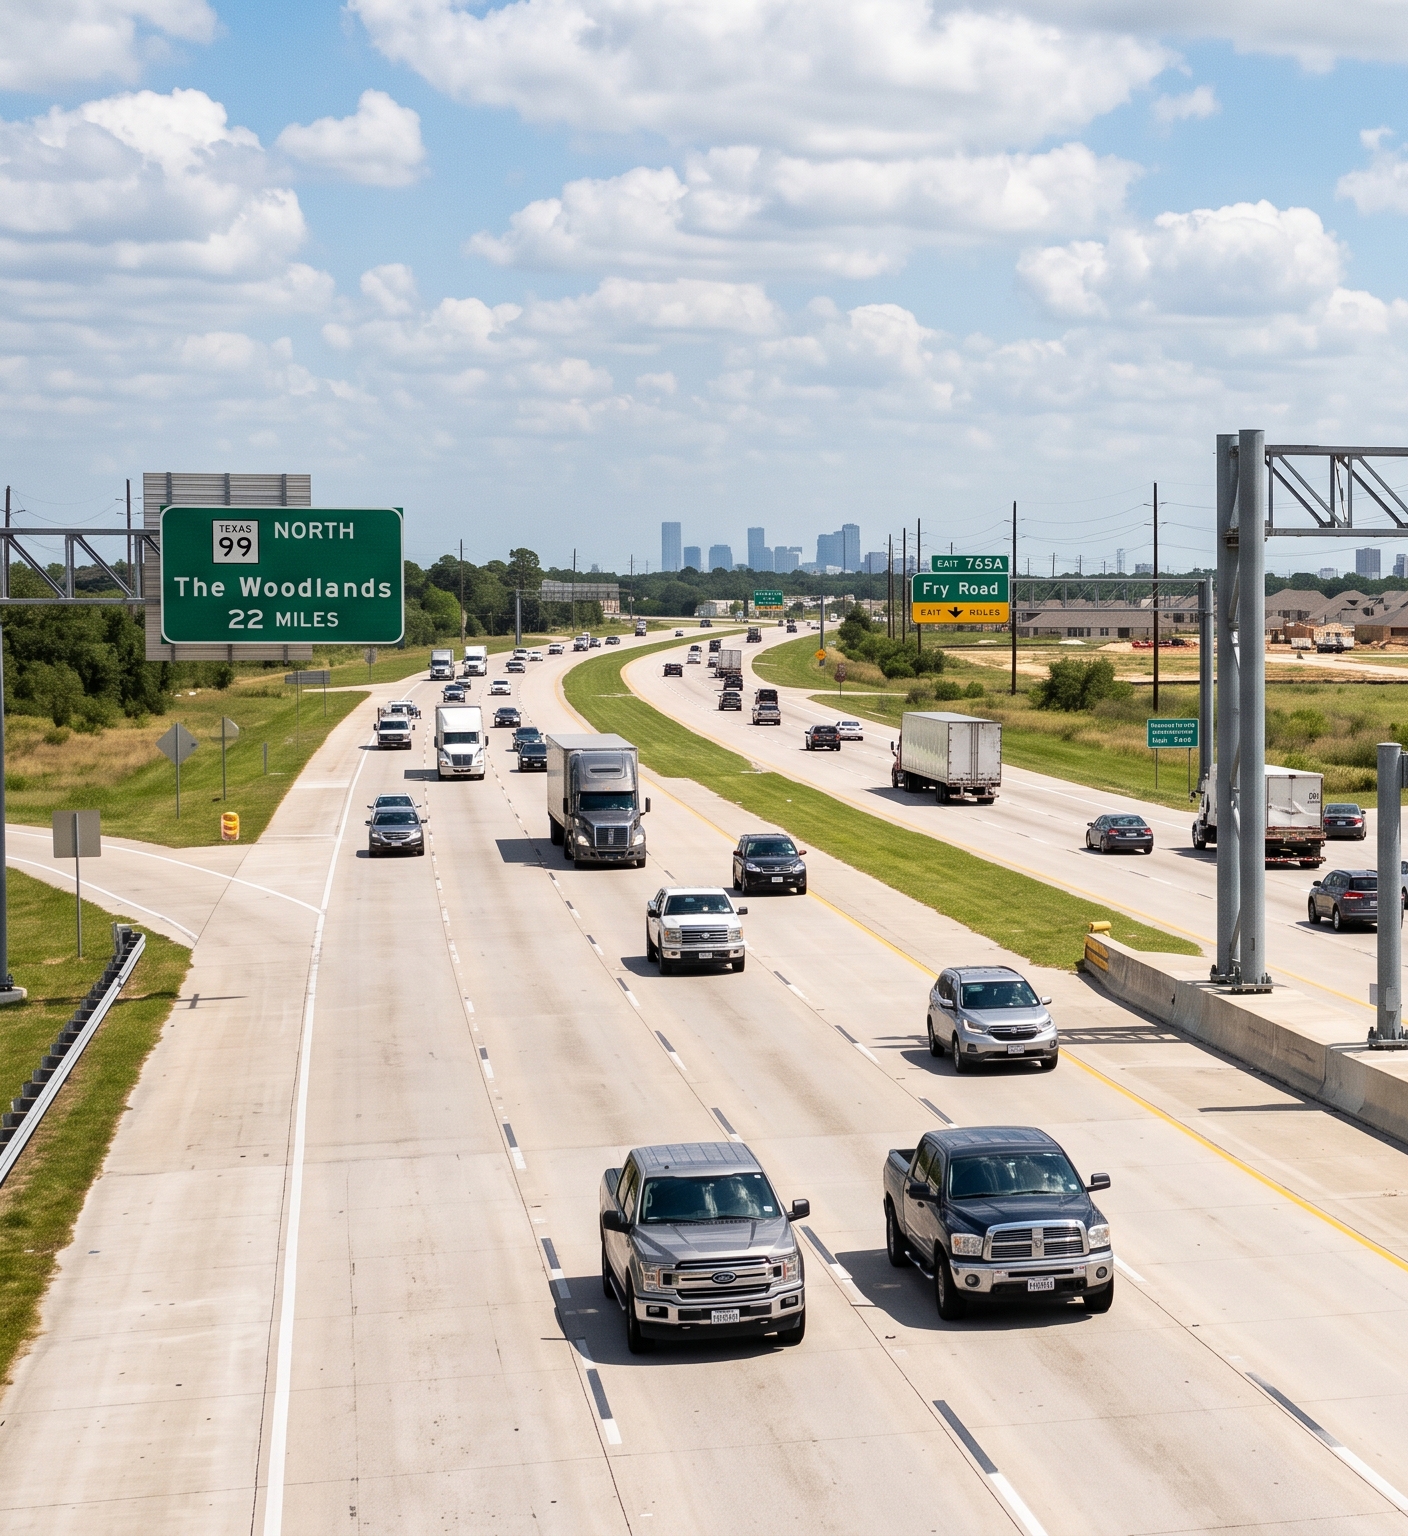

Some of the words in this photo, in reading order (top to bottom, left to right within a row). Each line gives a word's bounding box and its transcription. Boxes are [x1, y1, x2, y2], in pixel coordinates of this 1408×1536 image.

[218, 524, 252, 534] TEXAS
[274, 521, 354, 540] NORTH
[218, 536, 252, 558] 99
[965, 557, 1003, 570] 765A
[173, 576, 226, 598] The
[239, 576, 392, 598] Woodlands
[923, 582, 950, 598] Fry
[958, 581, 999, 595] Road
[228, 608, 264, 629] 22
[275, 611, 339, 628] MILES
